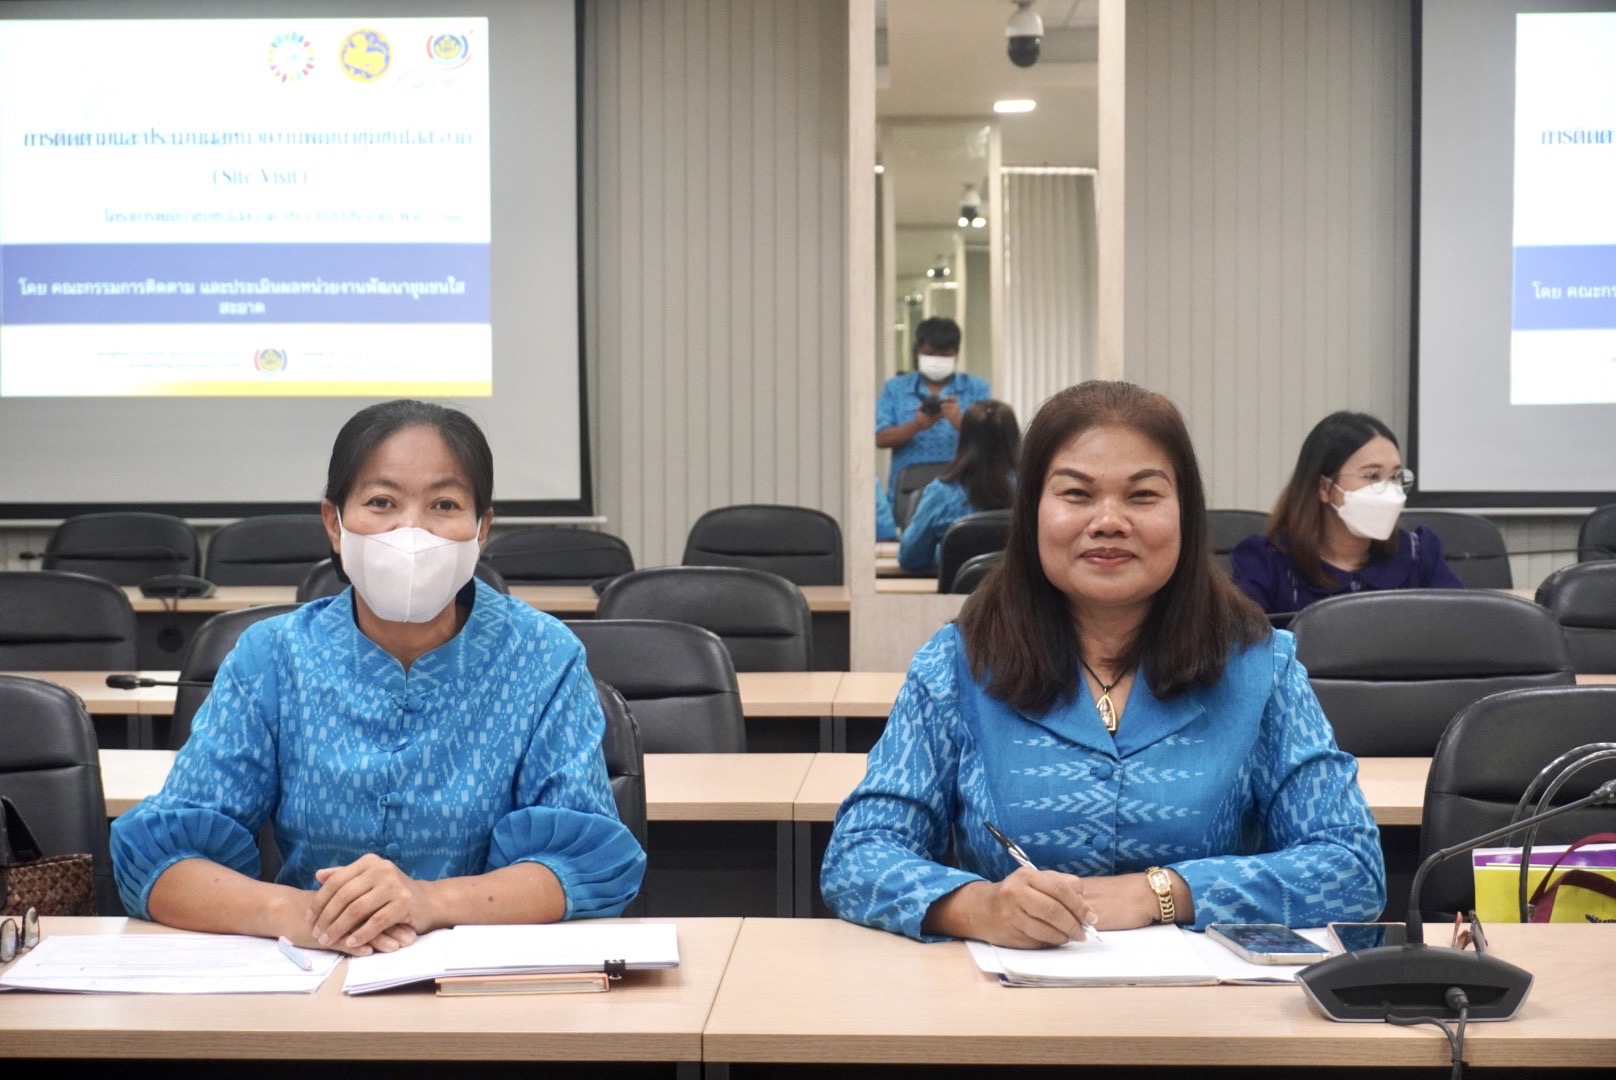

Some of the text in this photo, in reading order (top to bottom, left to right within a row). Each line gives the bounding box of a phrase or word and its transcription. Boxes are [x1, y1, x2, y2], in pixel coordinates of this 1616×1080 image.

[18, 277, 47, 296] โดย
[51, 278, 196, 297] คณะกรรมการติดตาม
[1531, 280, 1562, 299] โดย
[218, 301, 266, 316] สะอาด
